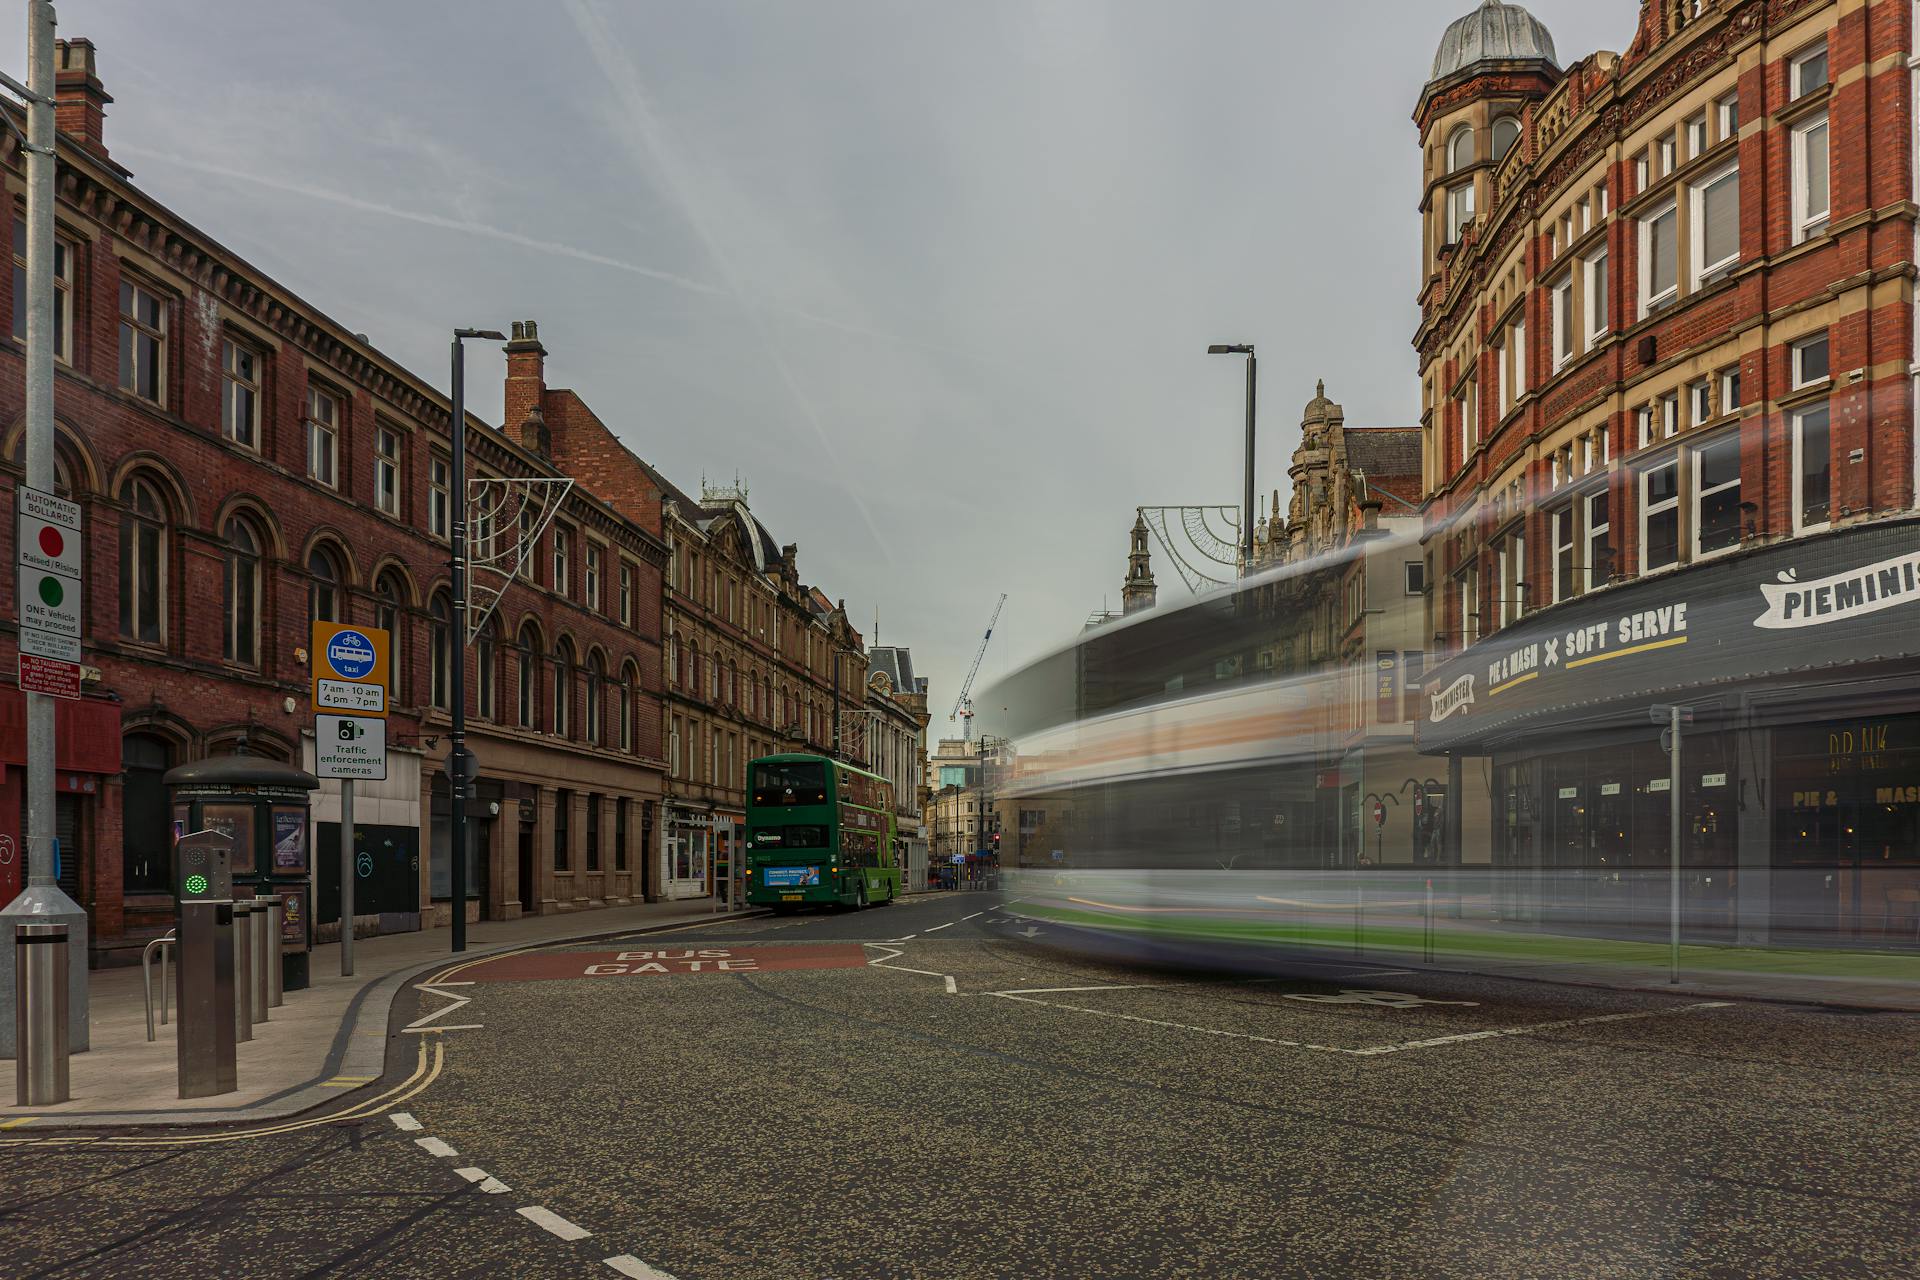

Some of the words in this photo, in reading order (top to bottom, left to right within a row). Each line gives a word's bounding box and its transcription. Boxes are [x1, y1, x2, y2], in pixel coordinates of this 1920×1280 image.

[25, 492, 76, 515] AUTOMATIC
[28, 503, 74, 525] BOLLARDS
[1784, 562, 1920, 620] PIEMINI
[26, 604, 45, 616] ONE
[48, 608, 76, 623] Vehicle
[26, 616, 43, 628] may
[45, 620, 76, 634] proceed
[1488, 660, 1501, 686] PIE
[1502, 657, 1509, 680] &
[1510, 643, 1538, 676] MASH
[1565, 622, 1608, 657] SOFT
[1618, 602, 1687, 643] SERVE
[344, 664, 358, 673] taxi
[322, 684, 328, 692] 7
[352, 687, 363, 695] 10
[365, 689, 380, 697] am
[1434, 680, 1470, 717] PIEMINISTER
[324, 694, 331, 702] 4
[333, 696, 348, 704] pm
[356, 697, 362, 705] 7
[363, 699, 378, 707] pm
[336, 745, 367, 755] Traffic
[321, 754, 382, 765] enforcement
[331, 766, 372, 775] cameras
[1792, 792, 1820, 807] PIE
[1826, 790, 1838, 806] &
[1876, 786, 1920, 804] MAS
[617, 950, 731, 960] BUS
[584, 958, 758, 974] GATE
